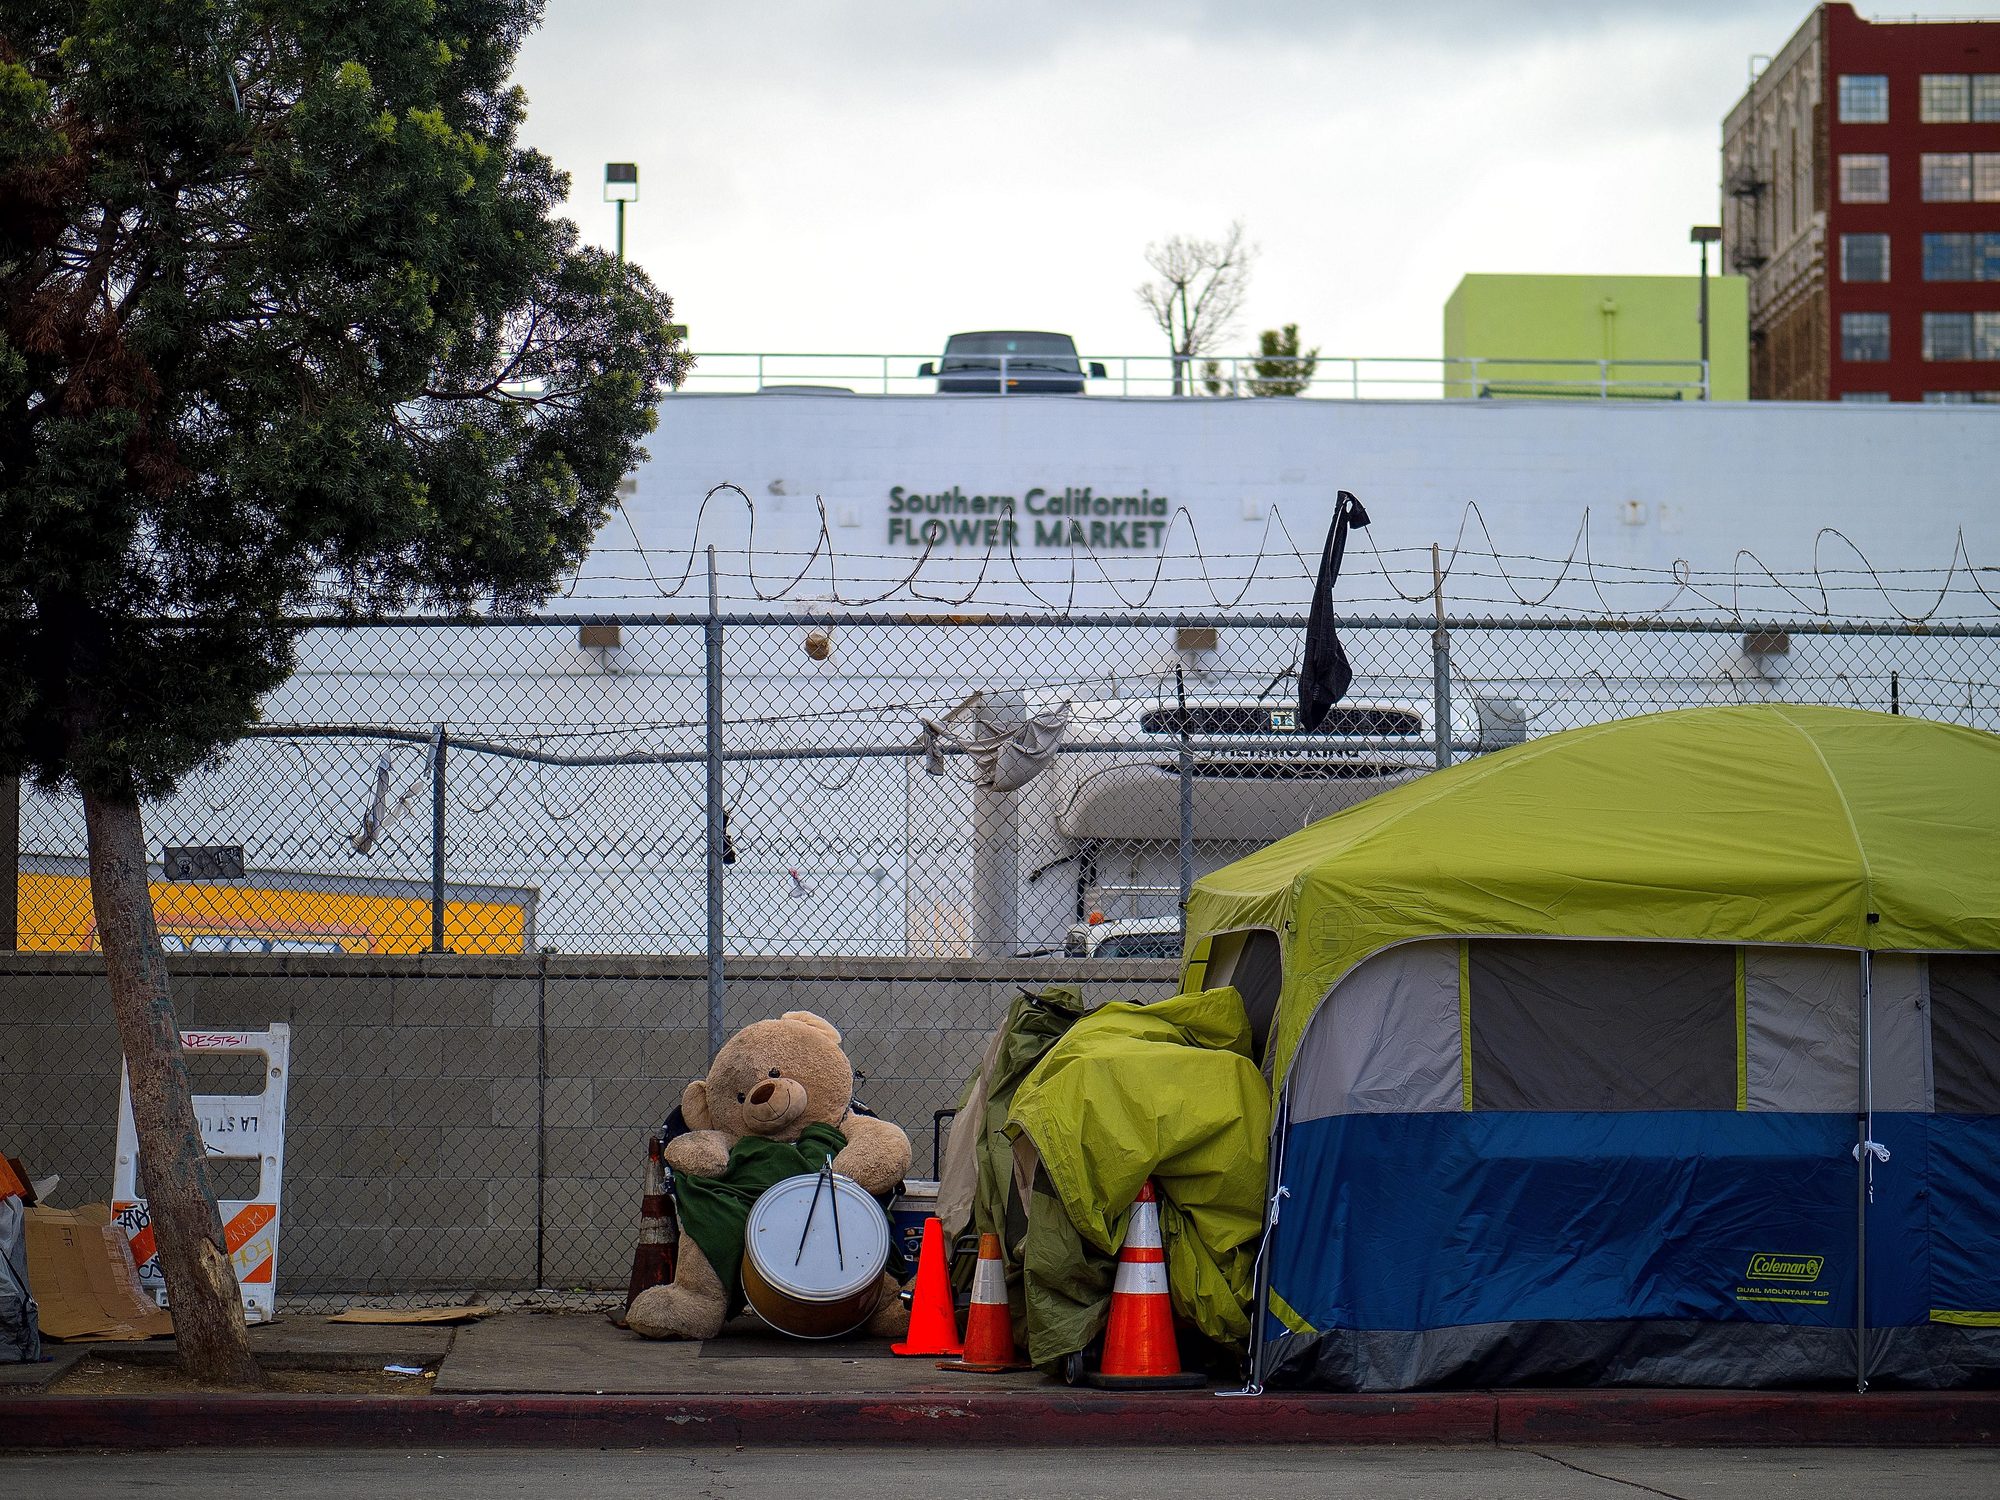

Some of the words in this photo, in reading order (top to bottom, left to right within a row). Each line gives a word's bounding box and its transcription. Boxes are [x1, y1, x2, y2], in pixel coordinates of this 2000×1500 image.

[888, 485, 1015, 514] Southern
[1024, 487, 1169, 516] California
[887, 518, 1019, 547] FLOWER
[1034, 519, 1168, 548] MARKET
[1753, 1257, 1806, 1274] Coleman
[1763, 1288, 1809, 1296] MOUNTAIN
